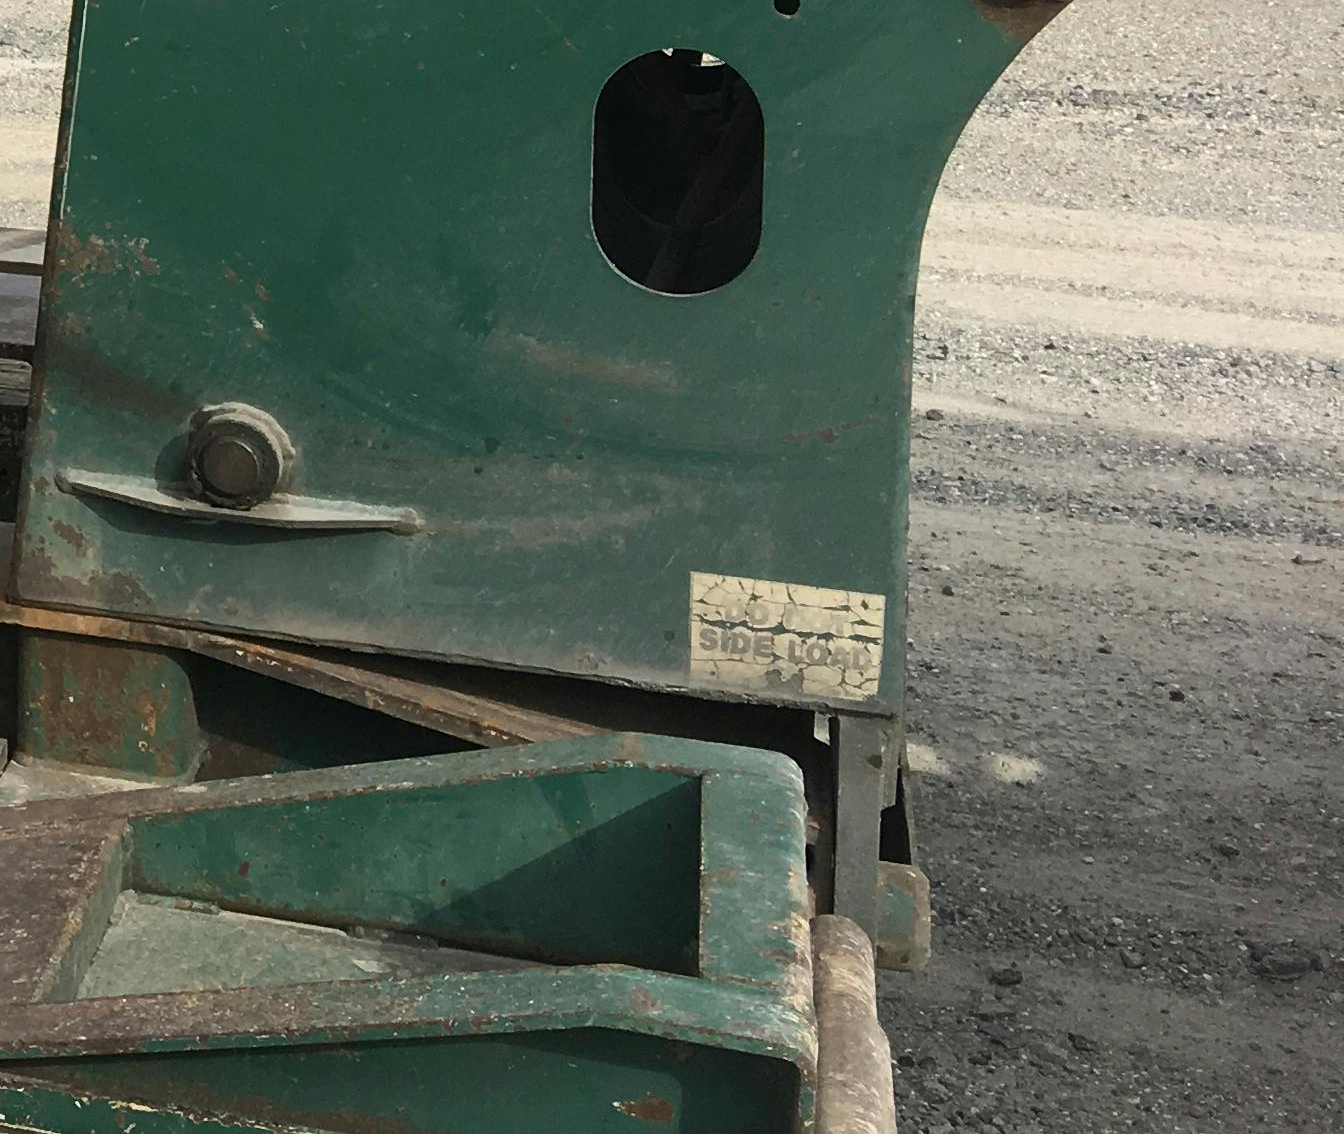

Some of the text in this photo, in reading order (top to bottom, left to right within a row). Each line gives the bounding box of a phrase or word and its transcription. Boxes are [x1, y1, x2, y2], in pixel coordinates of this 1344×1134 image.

[723, 598, 770, 626] DO
[698, 627, 873, 671] SIDE LOAD
